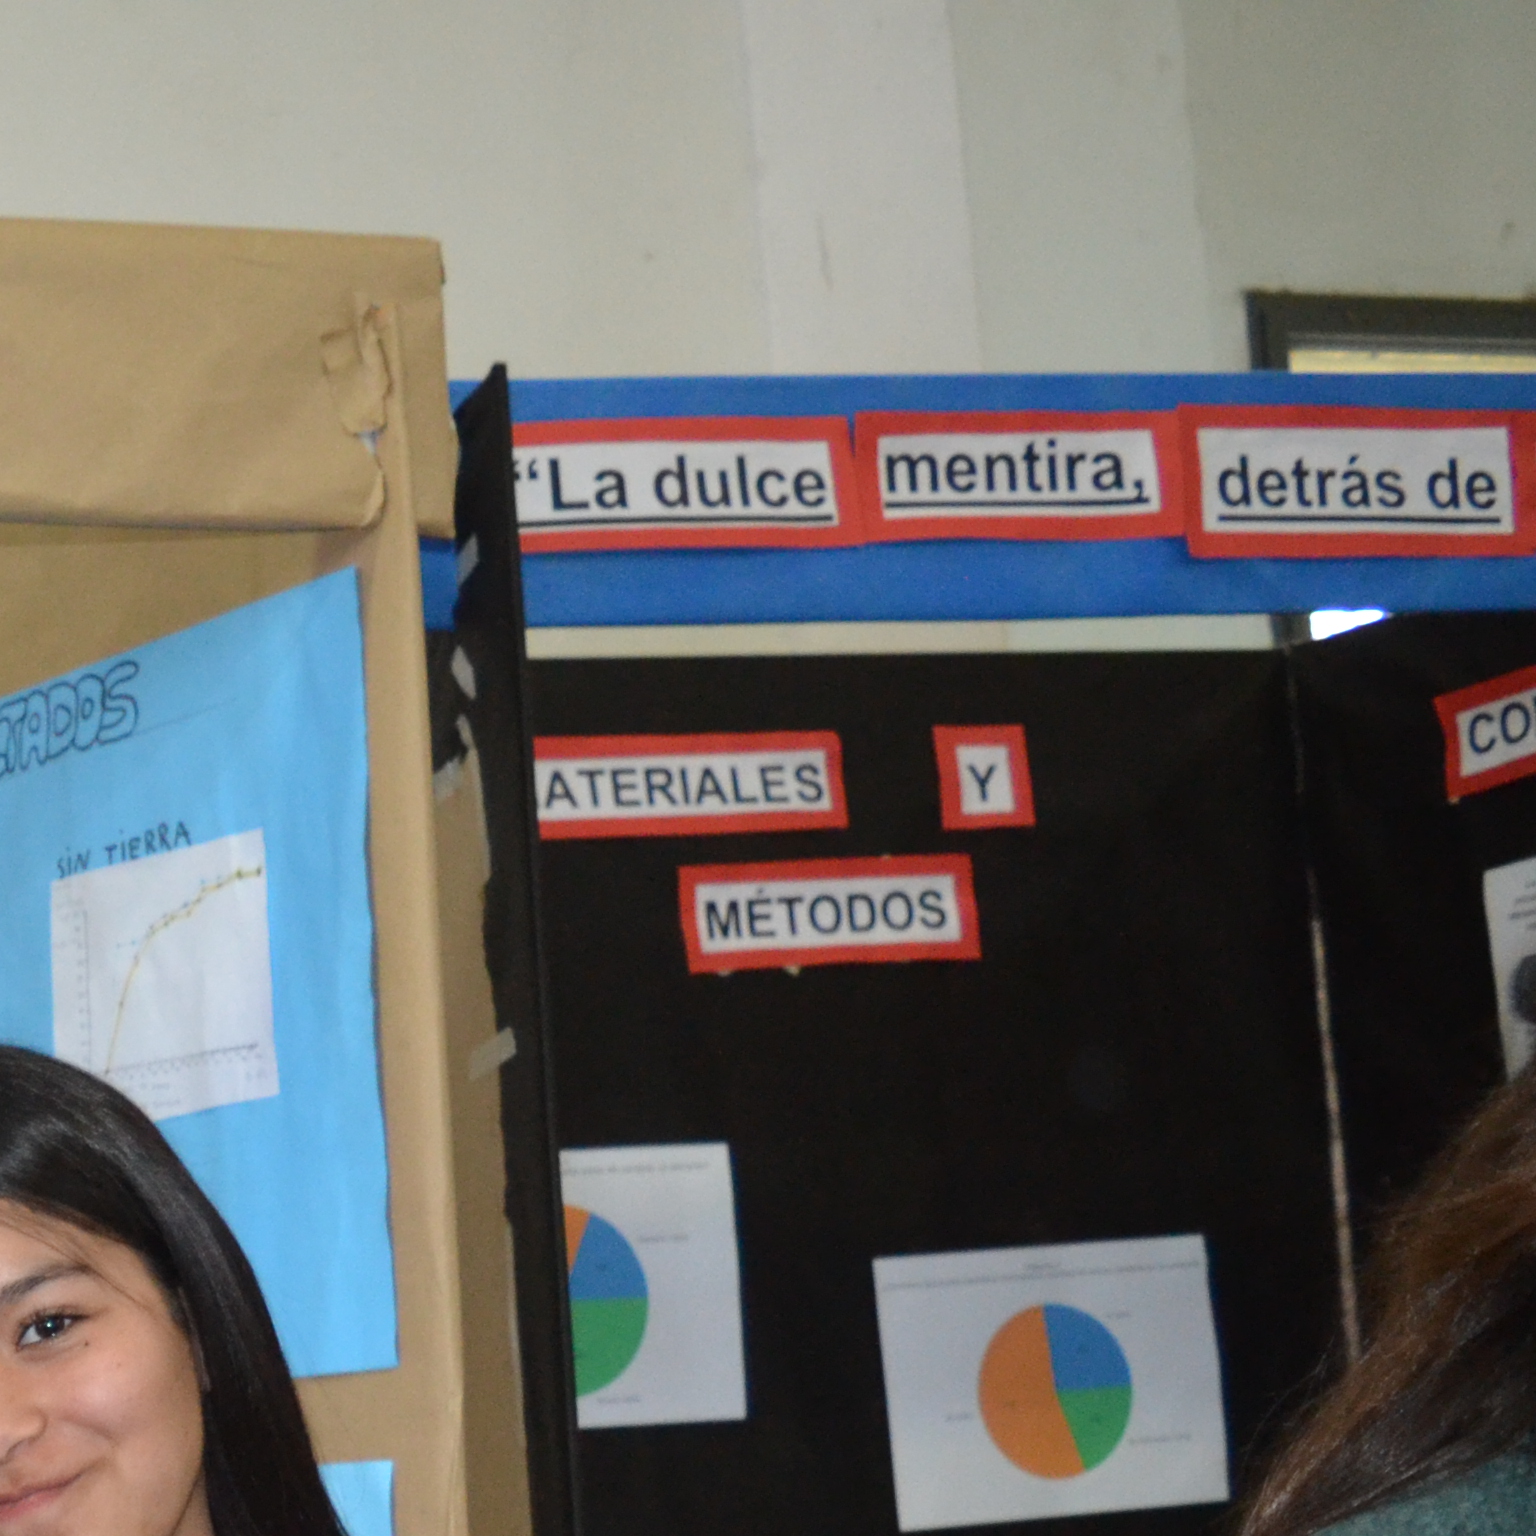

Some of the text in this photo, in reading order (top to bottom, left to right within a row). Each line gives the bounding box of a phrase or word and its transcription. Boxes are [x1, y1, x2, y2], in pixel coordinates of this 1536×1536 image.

[655, 454, 826, 508] dulce
[885, 439, 1146, 501] mentira,
[1218, 455, 1406, 509] detrás
[1428, 457, 1498, 510] de
[544, 762, 997, 809] ATERIALES Y
[56, 821, 193, 880] SIN TIERRA
[705, 889, 947, 940] MÉTODOS
